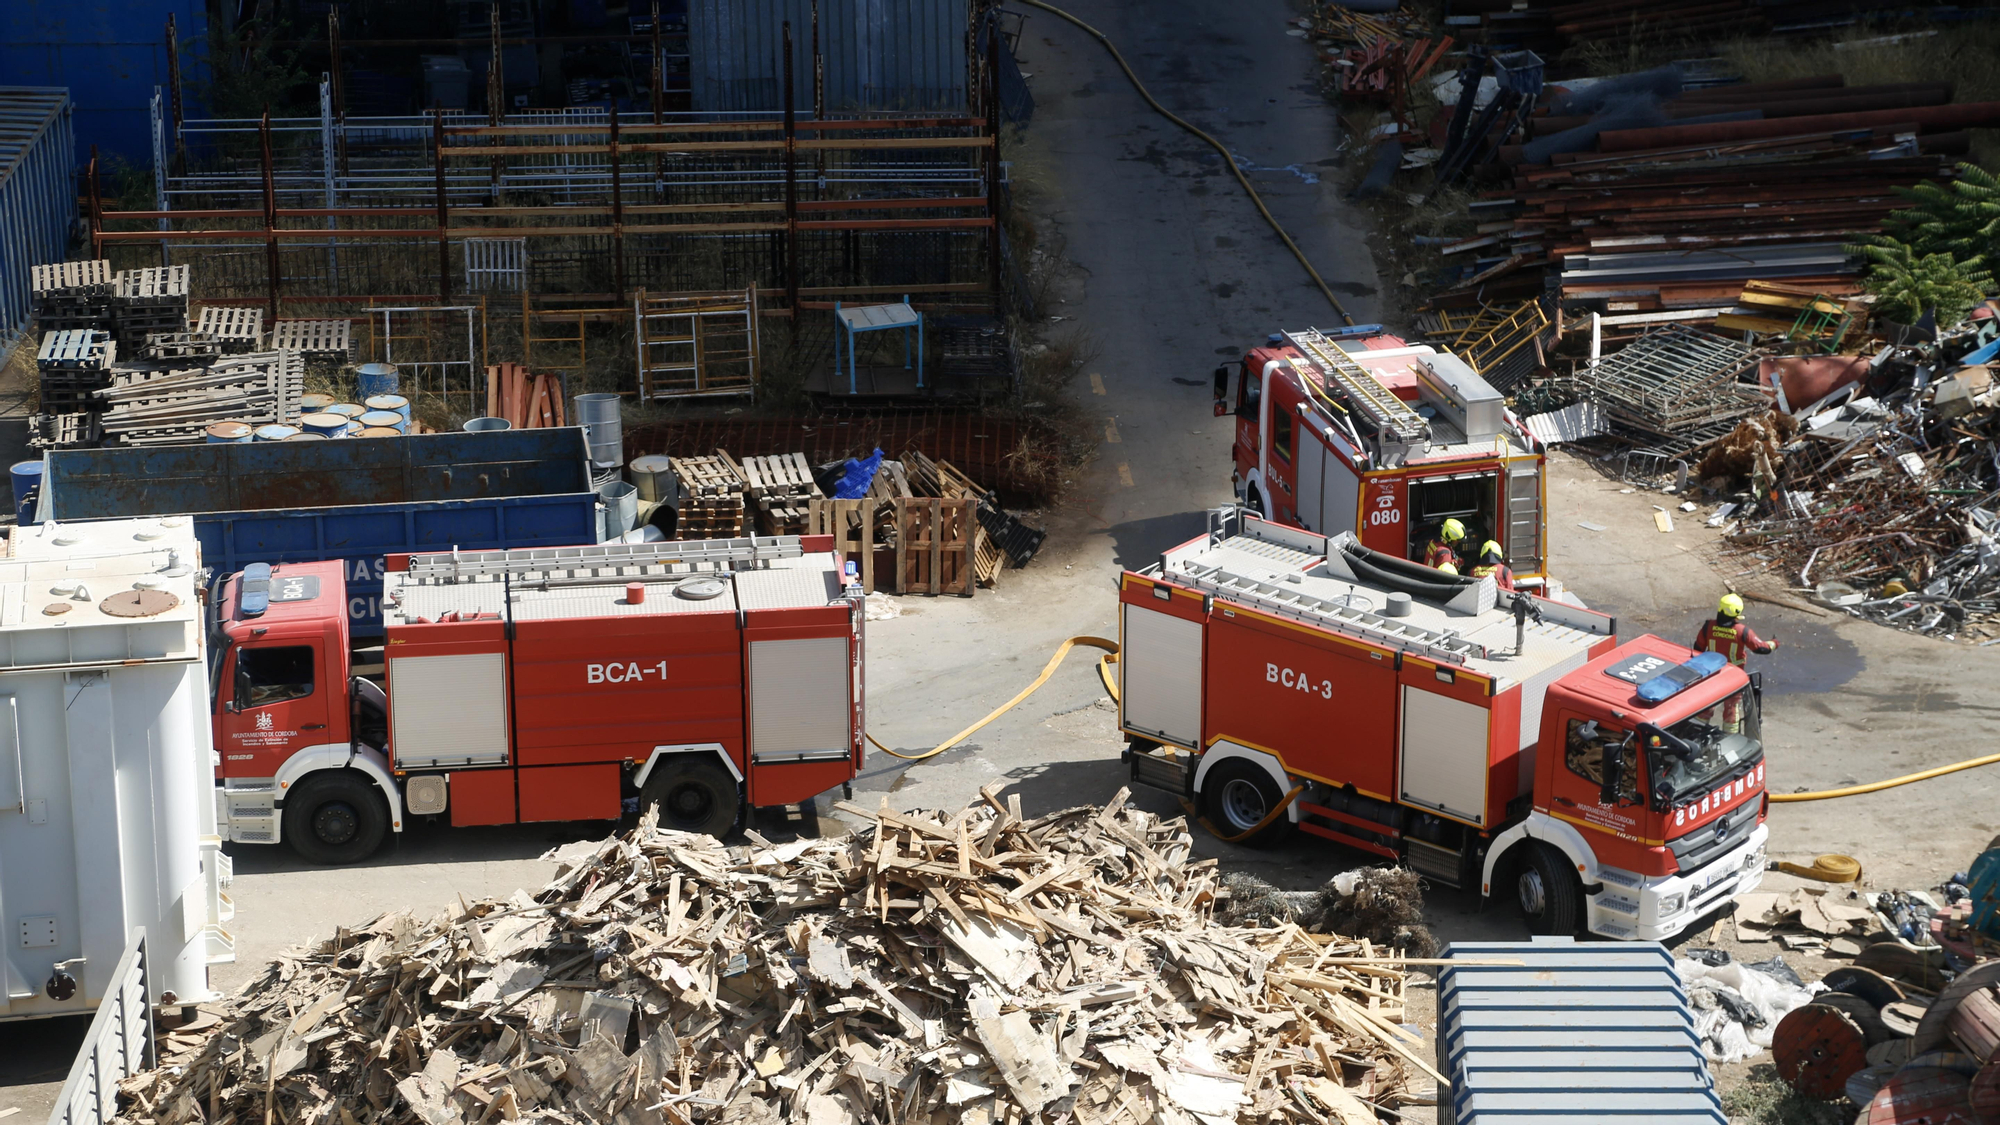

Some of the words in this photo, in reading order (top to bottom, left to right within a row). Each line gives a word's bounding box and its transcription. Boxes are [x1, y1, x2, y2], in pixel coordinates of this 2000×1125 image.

[1371, 509, 1400, 525] 080
[283, 576, 304, 599] BCA-1
[348, 597, 384, 619] CI
[587, 660, 667, 683] BCA-1
[1618, 656, 1665, 679] BCA-3
[1266, 662, 1332, 699] BCA-3
[1577, 803, 1608, 818] AYUNTAMIENTO
[1608, 811, 1615, 819] DE
